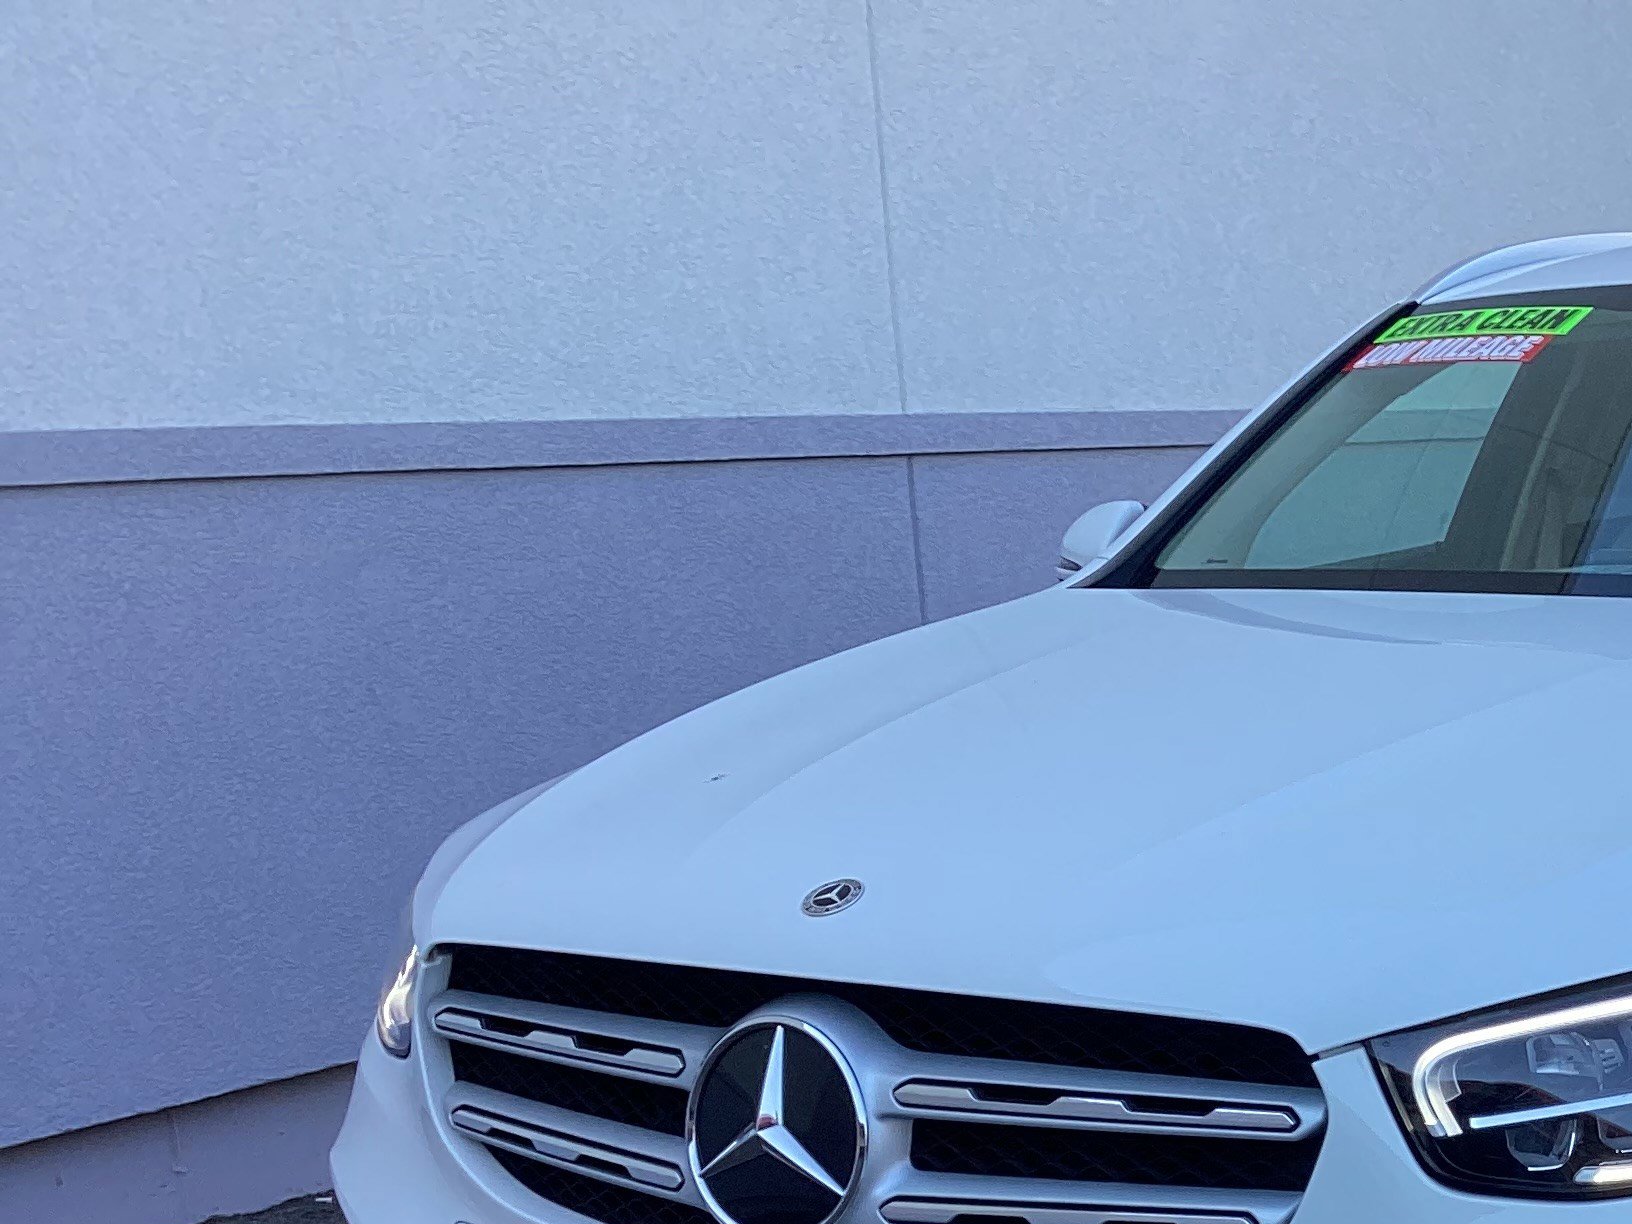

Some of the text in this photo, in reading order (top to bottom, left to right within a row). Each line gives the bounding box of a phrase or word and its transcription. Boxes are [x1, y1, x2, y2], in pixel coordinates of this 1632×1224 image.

[1386, 309, 1582, 338] EXTRA CLEAN
[1408, 335, 1545, 363] MILEAGE
